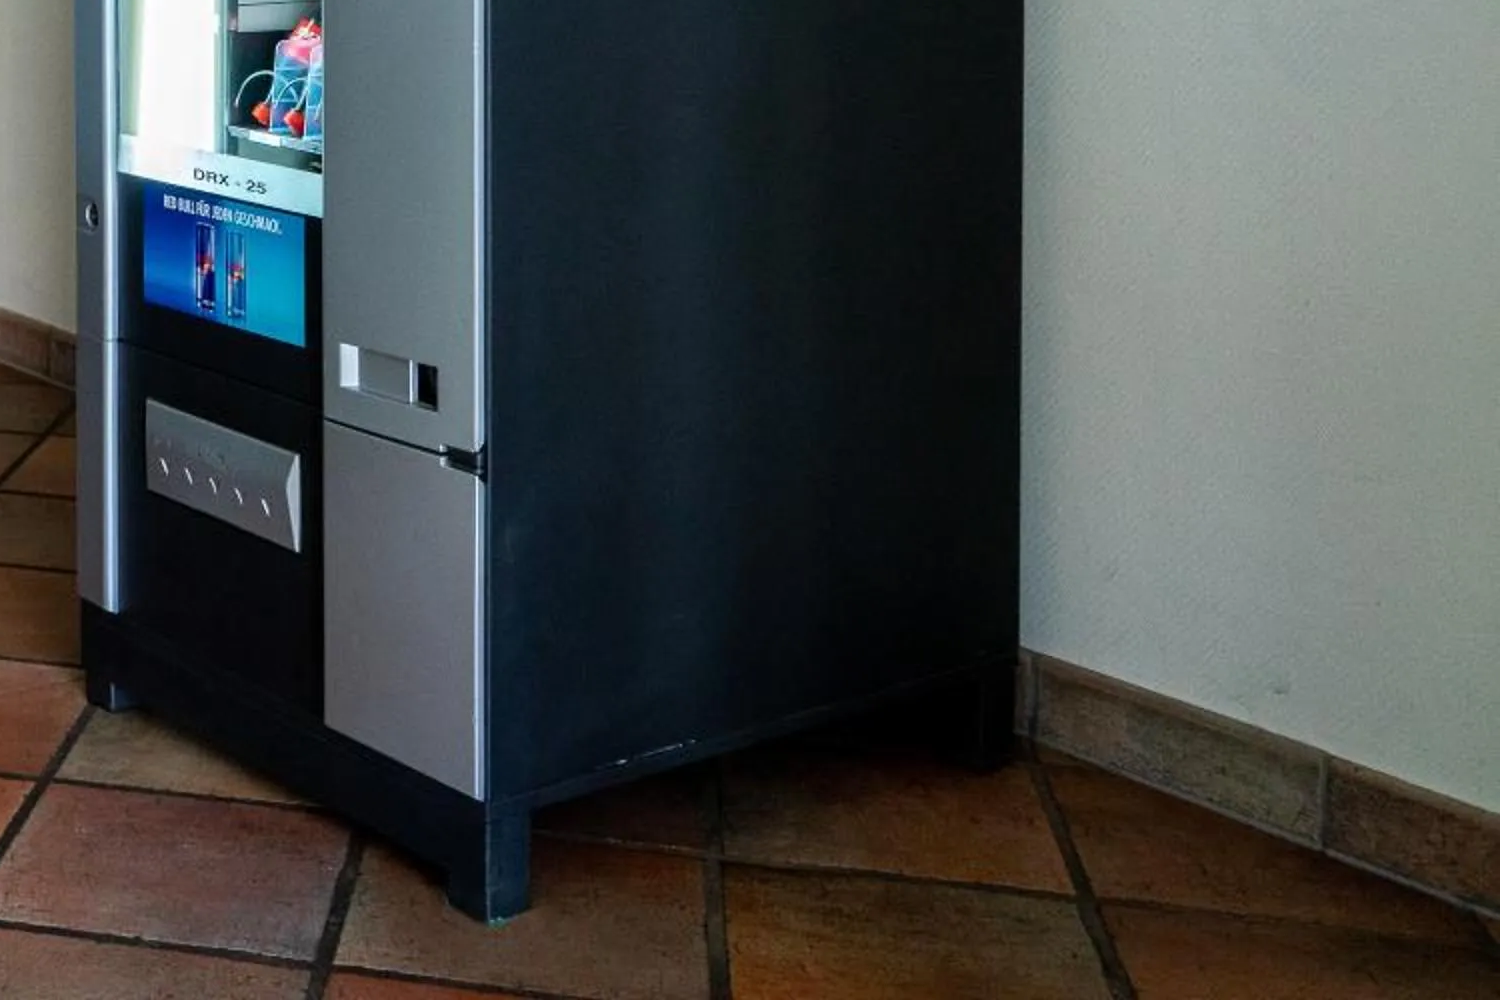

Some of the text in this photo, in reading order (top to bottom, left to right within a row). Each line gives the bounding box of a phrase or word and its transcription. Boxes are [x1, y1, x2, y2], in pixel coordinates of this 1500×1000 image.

[193, 168, 230, 187] DRX
[245, 179, 268, 195] 25
[163, 194, 177, 209] RED
[178, 197, 195, 215] BULL
[196, 199, 211, 218] FÜR
[212, 206, 233, 223] JEDEN
